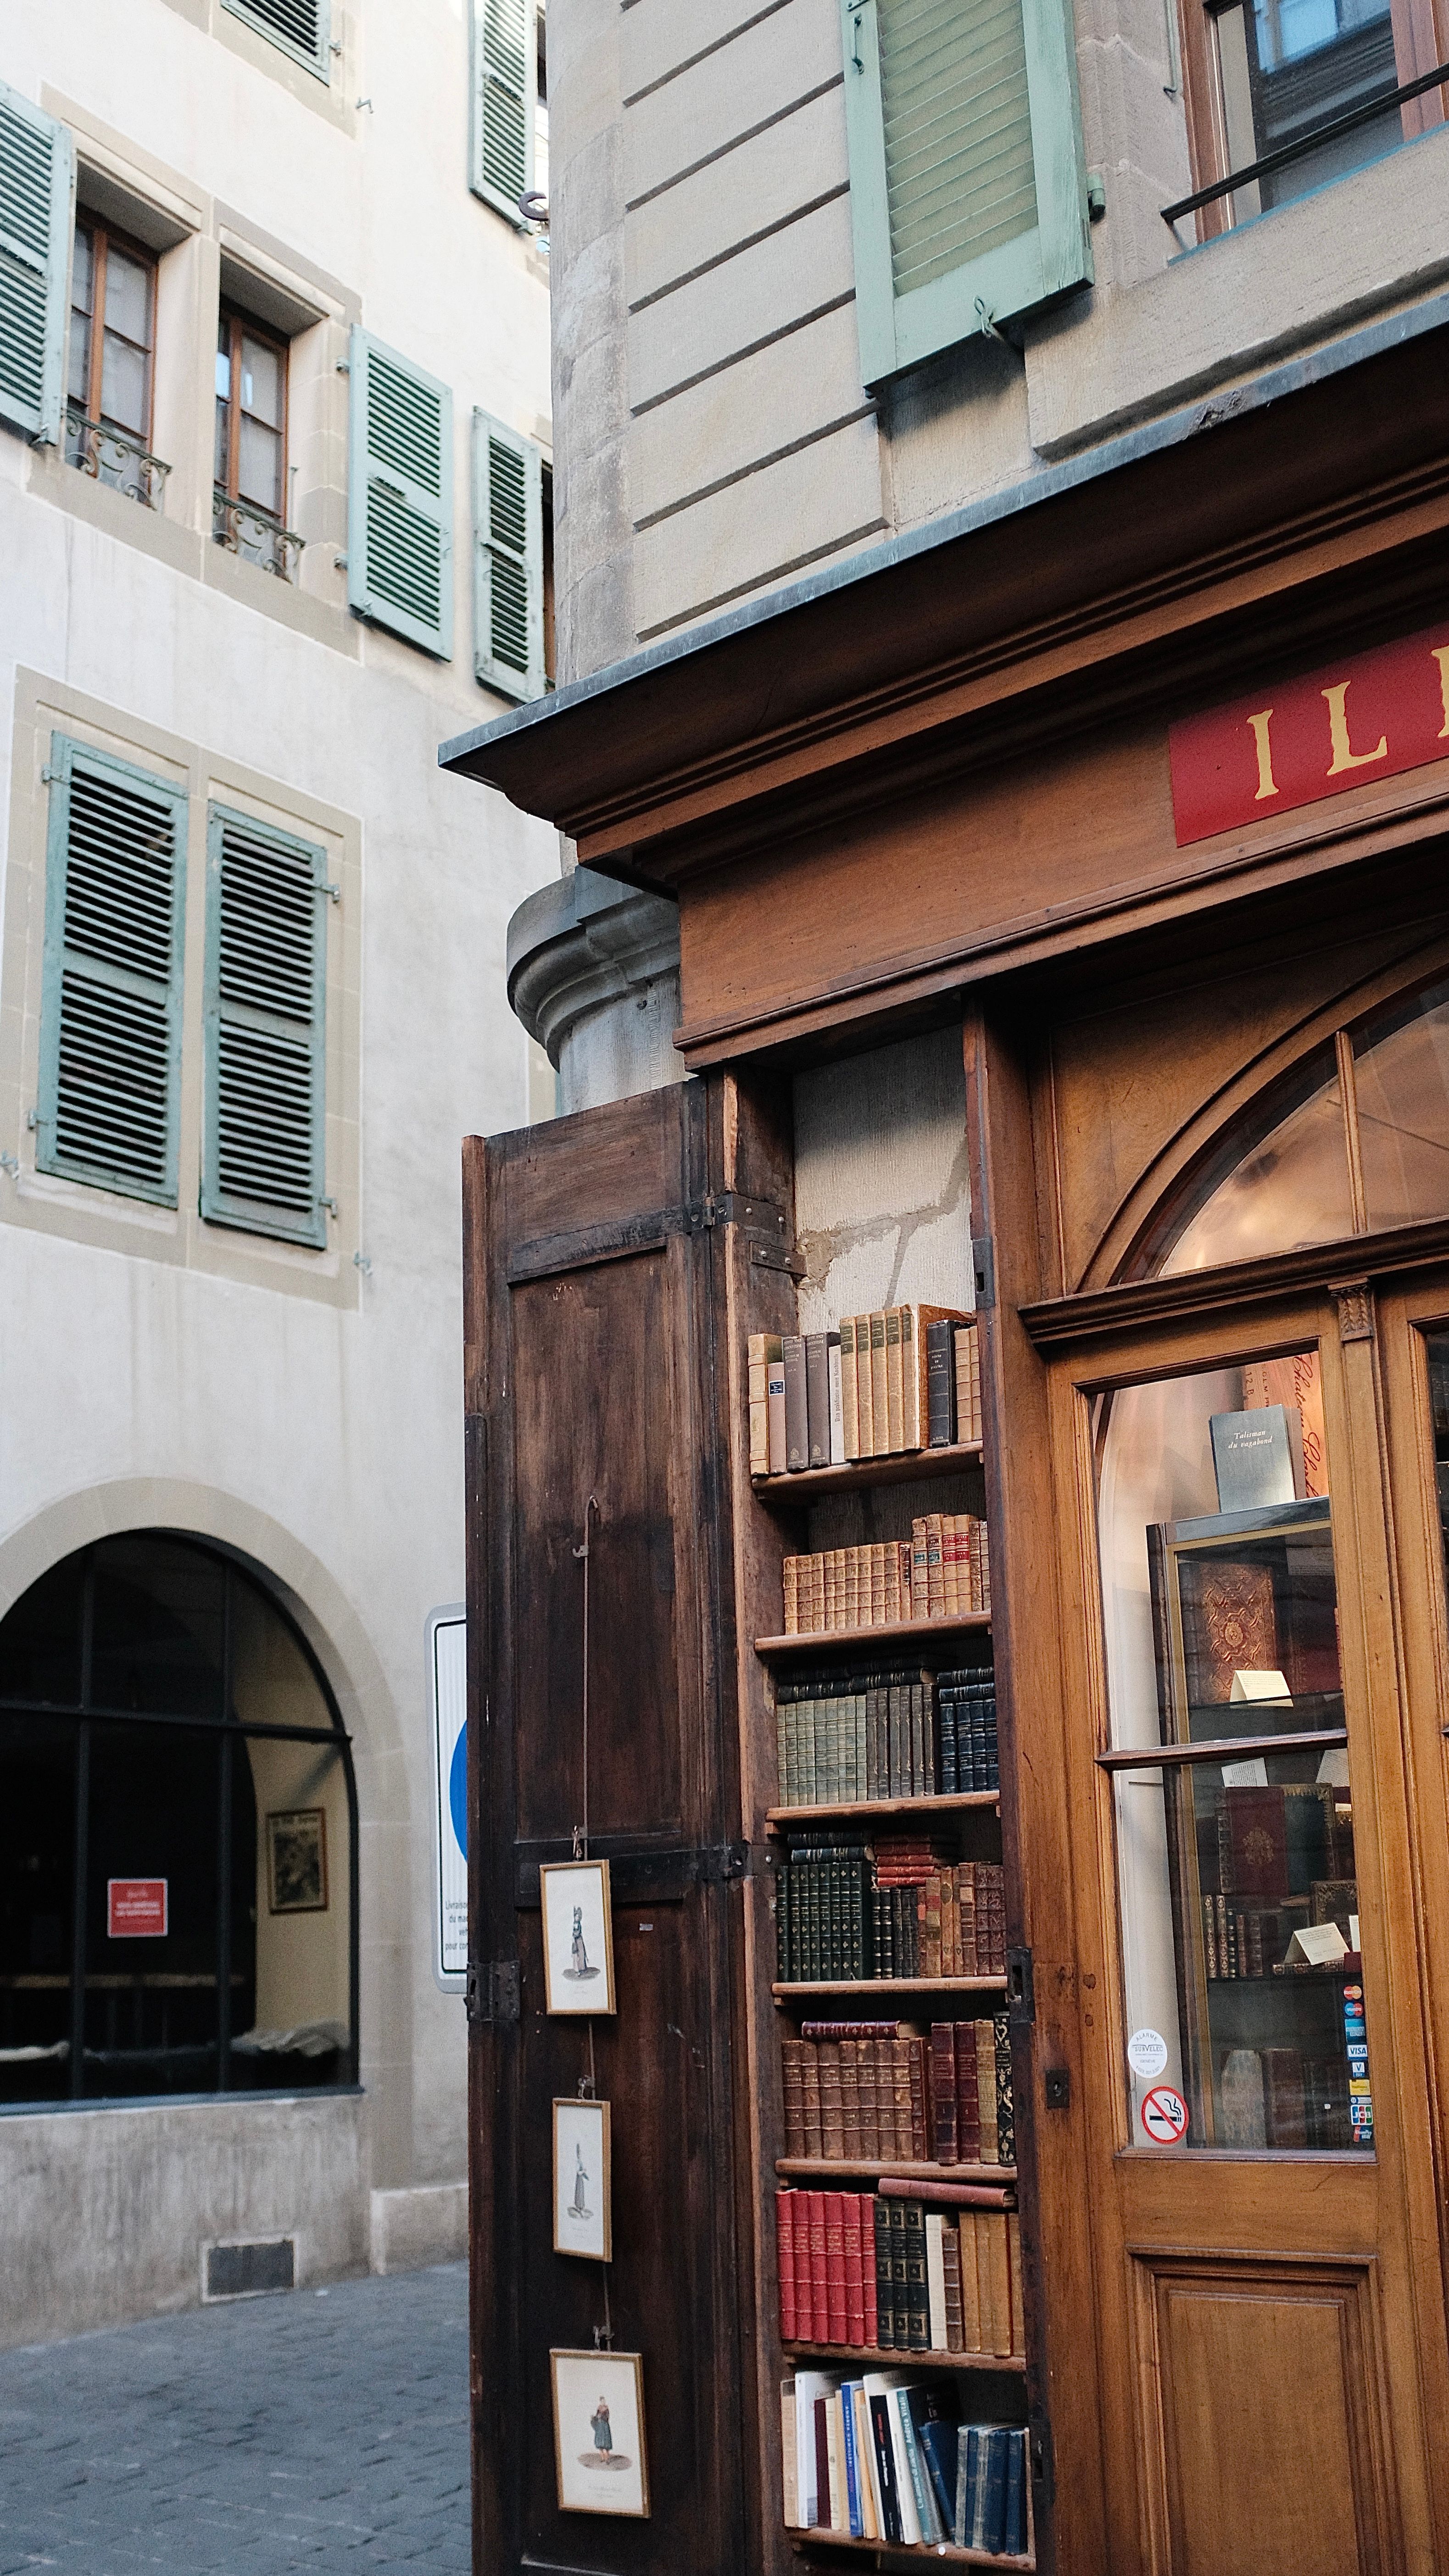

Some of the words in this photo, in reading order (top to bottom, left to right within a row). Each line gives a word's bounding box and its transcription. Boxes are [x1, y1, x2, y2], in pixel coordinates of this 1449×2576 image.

[1234, 1431, 1265, 1439] Talisman
[1241, 1435, 1272, 1448] vagabond
[1137, 2032, 1157, 2041] ALARME
